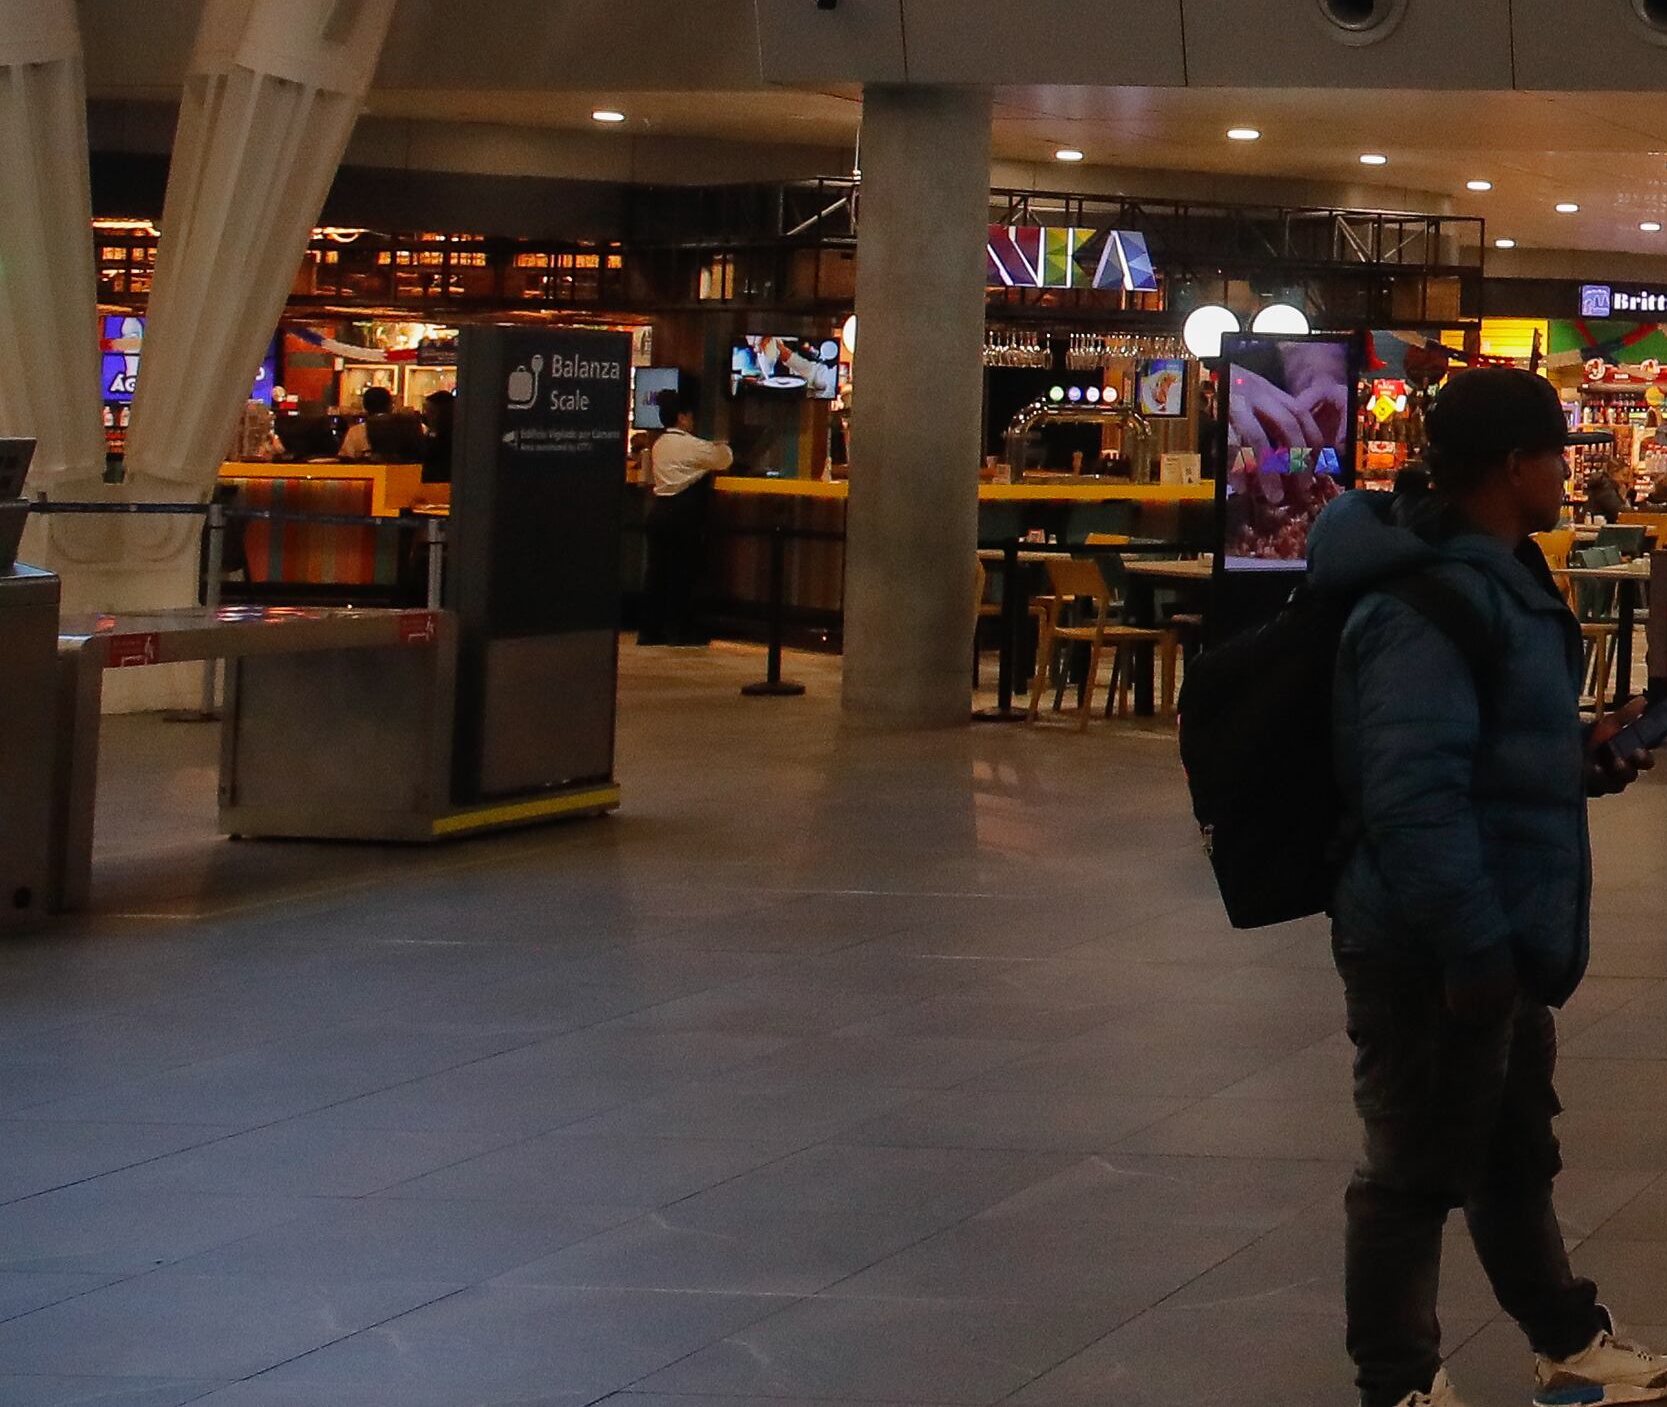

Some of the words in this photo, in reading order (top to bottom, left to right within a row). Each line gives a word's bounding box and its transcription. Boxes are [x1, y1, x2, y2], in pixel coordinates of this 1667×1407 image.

[1613, 291, 1667, 312] Britt
[551, 353, 621, 380] Balanza
[550, 389, 591, 412] Scale
